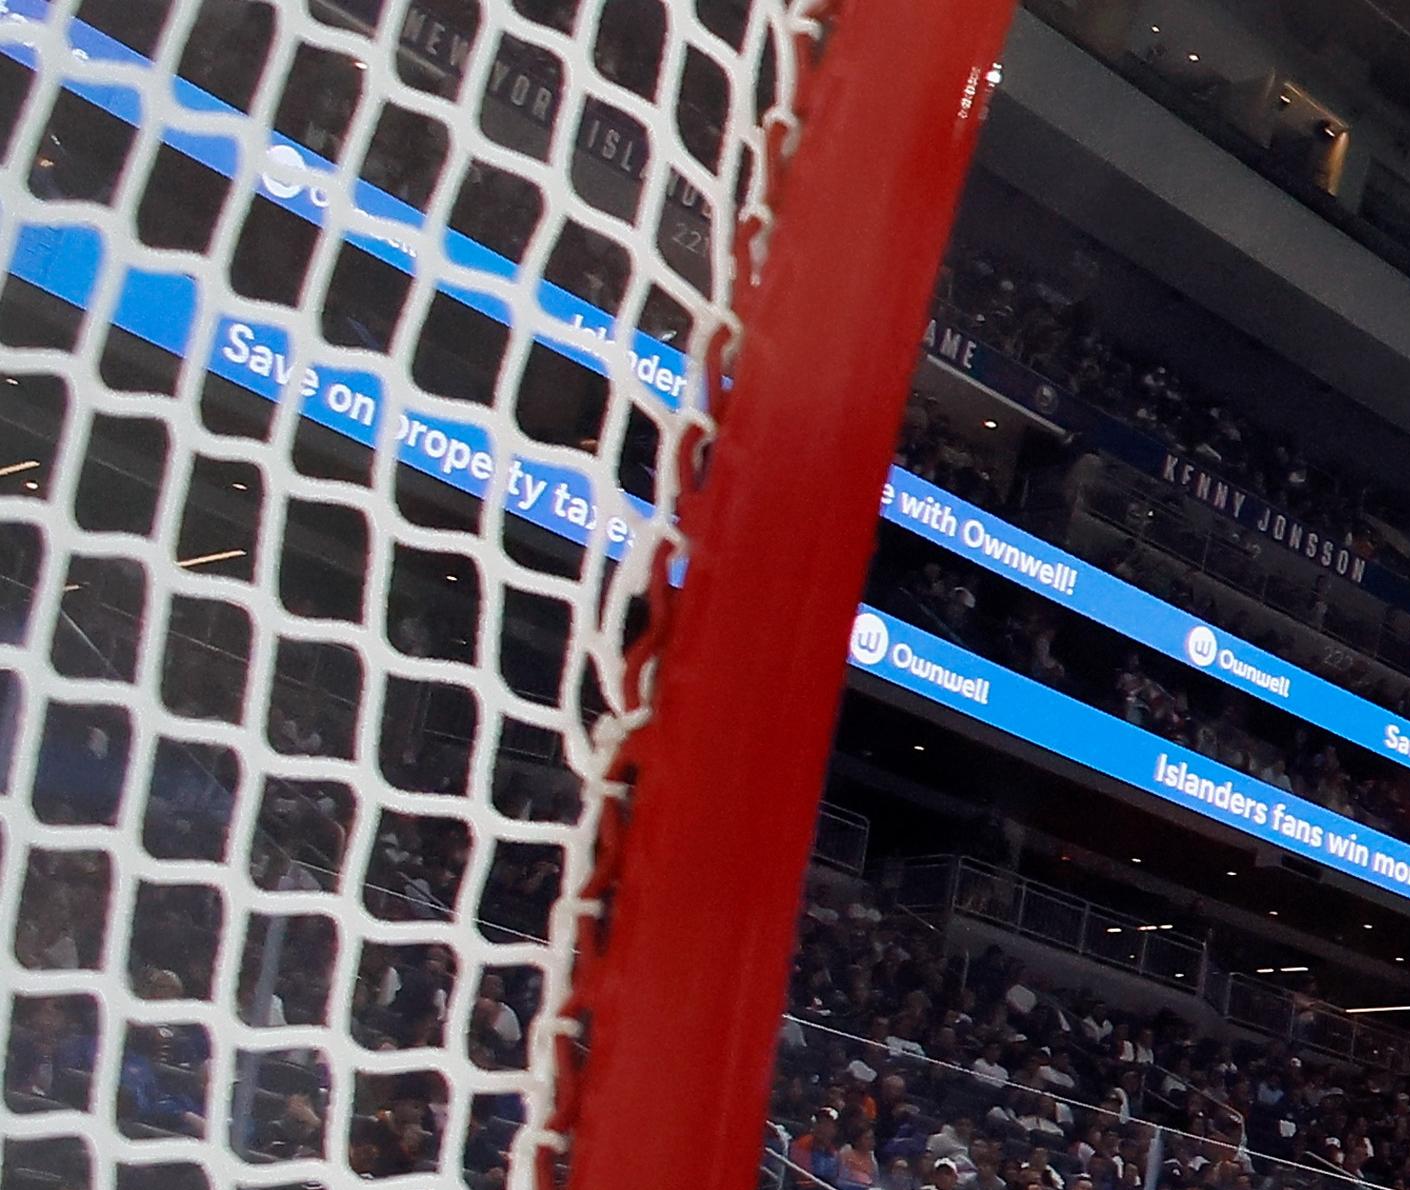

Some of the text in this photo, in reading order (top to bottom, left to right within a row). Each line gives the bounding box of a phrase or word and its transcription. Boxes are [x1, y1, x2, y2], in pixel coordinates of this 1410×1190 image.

[490, 61, 553, 121] YOR
[326, 381, 377, 426] on
[394, 407, 546, 512] ropety
[553, 477, 639, 549] tae
[900, 491, 957, 540] with
[961, 518, 1078, 596] Ownwell!
[1160, 452, 1368, 585] KENNY JONSSON
[892, 642, 990, 706] Ownwell
[1219, 647, 1291, 698] Ownwell
[1154, 753, 1268, 826] Islanders
[1272, 801, 1323, 848] fans
[1327, 832, 1369, 868] win
